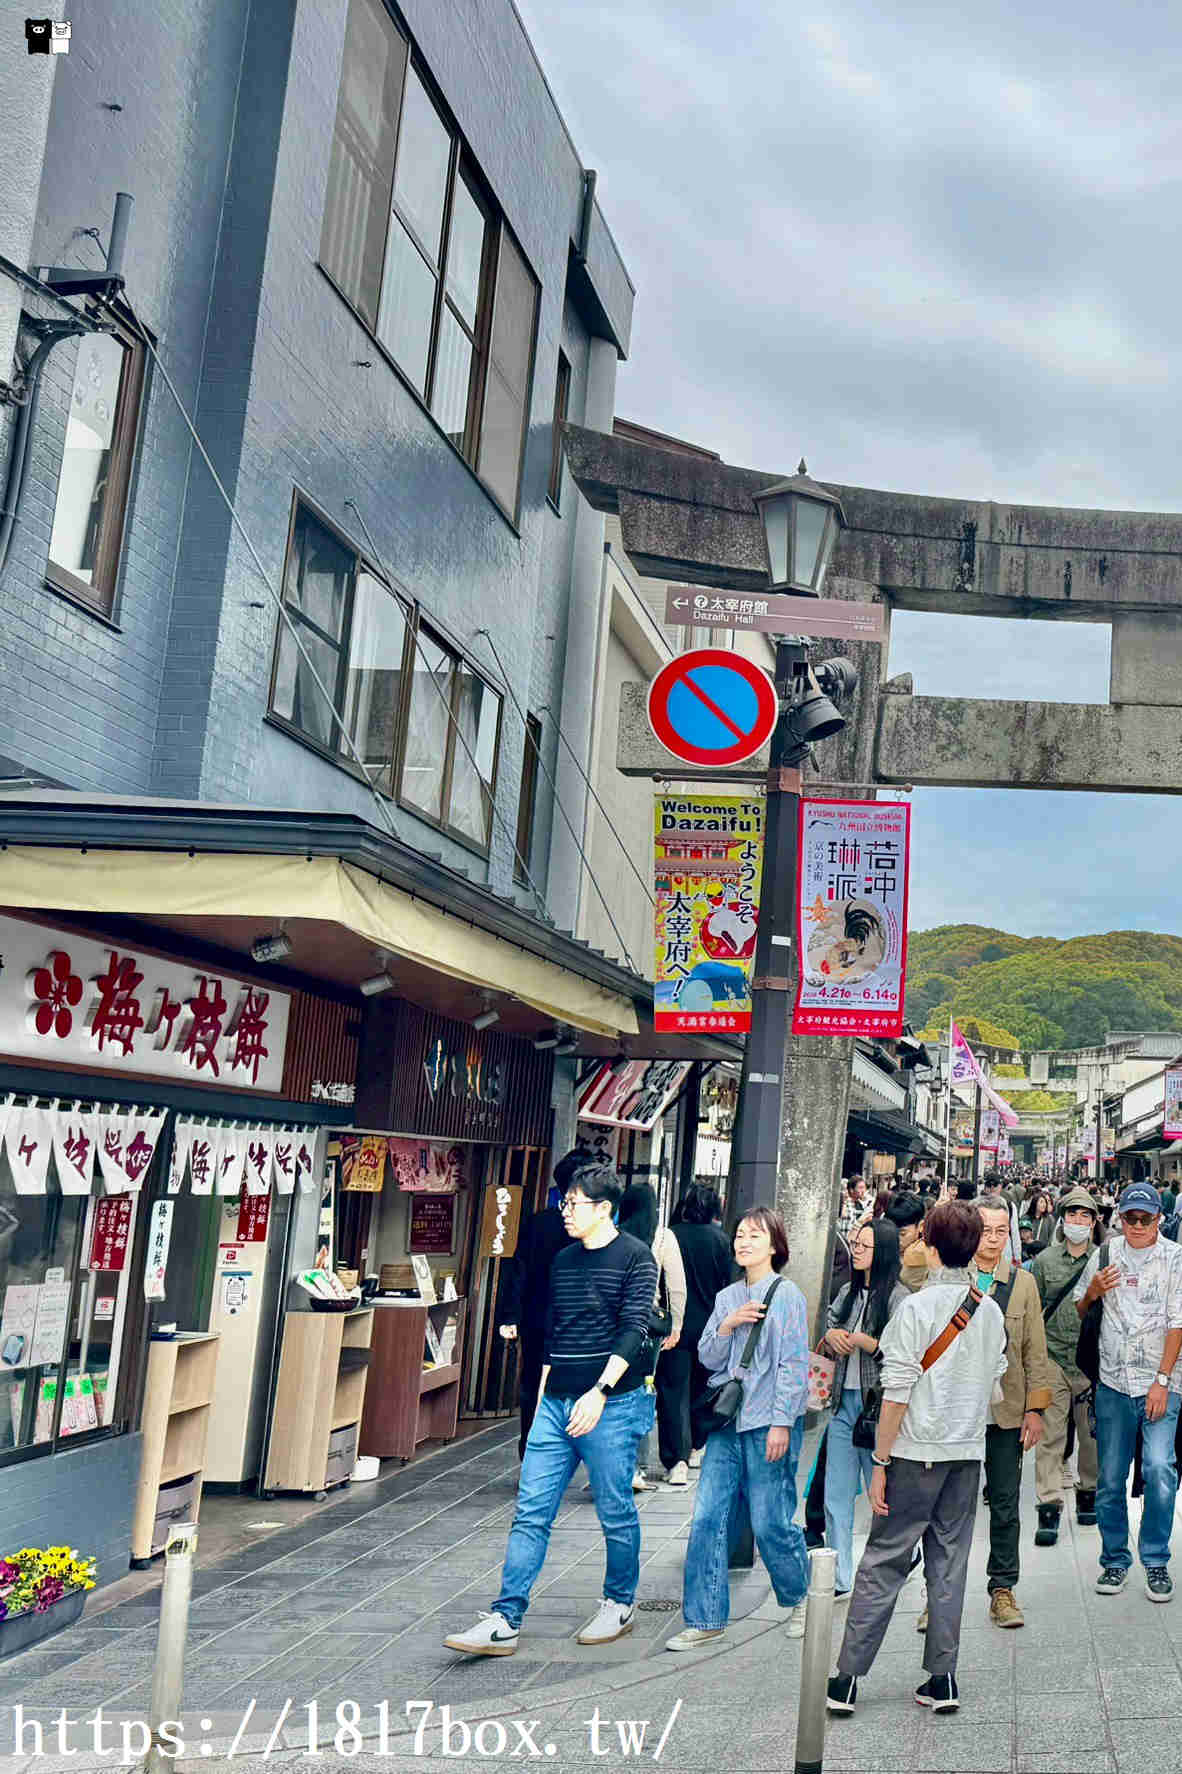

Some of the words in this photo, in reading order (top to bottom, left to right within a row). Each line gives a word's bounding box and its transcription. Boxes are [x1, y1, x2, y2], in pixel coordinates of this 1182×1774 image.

[711, 597, 769, 616] 太宰府館
[693, 612, 729, 623] Dazaifu
[735, 615, 754, 624] Hall
[661, 801, 737, 815] Welcome
[741, 803, 761, 815] To
[661, 814, 761, 832] Dazaifu!
[736, 840, 758, 924] ようこそ
